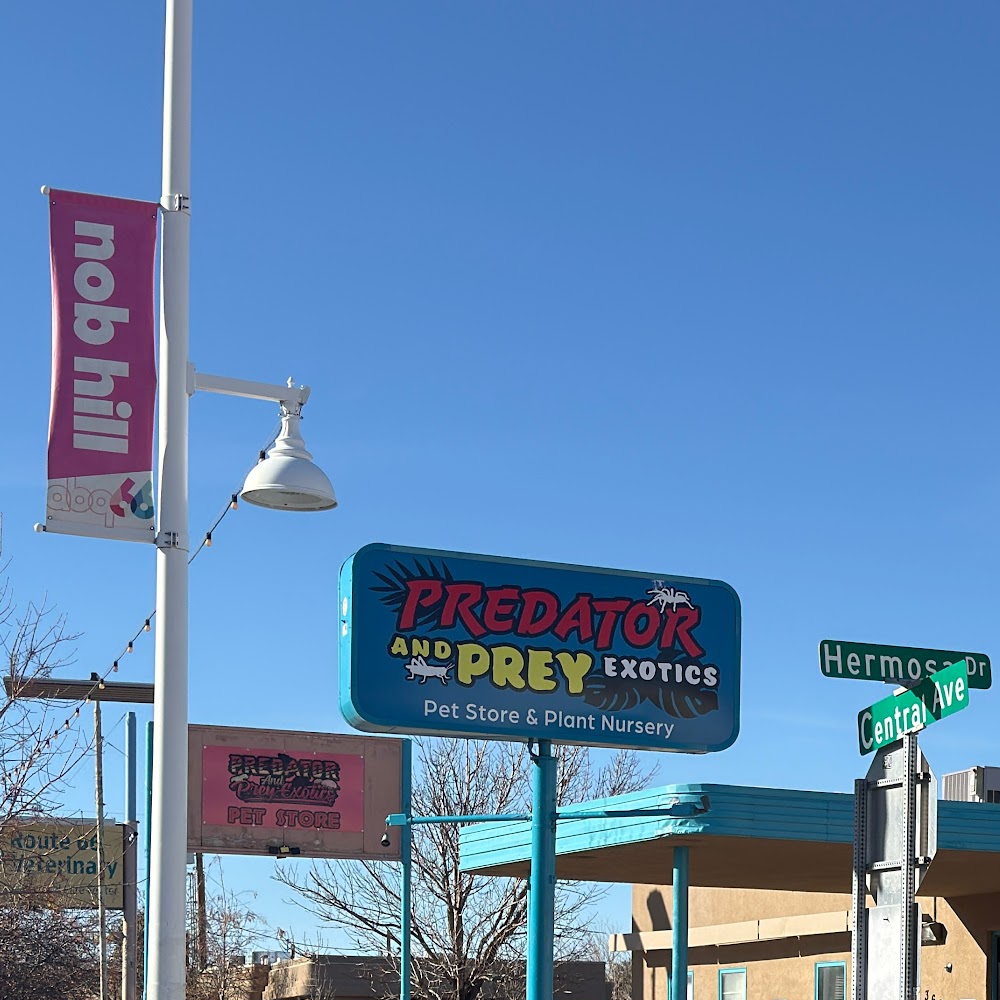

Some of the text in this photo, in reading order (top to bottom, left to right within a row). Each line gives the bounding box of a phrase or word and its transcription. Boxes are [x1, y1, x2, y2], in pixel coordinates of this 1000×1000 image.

[73, 220, 132, 454] nob hill
[399, 578, 703, 657] PREDATOR
[391, 636, 719, 694] AND PREY EXOTICS
[965, 656, 987, 677] Dr
[424, 699, 675, 739] Pet Store & Plant Nursery
[861, 677, 965, 750] Central Ave
[228, 754, 340, 780] PREDATOR
[261, 775, 285, 785] And
[233, 780, 336, 801] Prey Exotics
[228, 806, 341, 830] PET STORE
[12, 855, 118, 880] Veterinay
